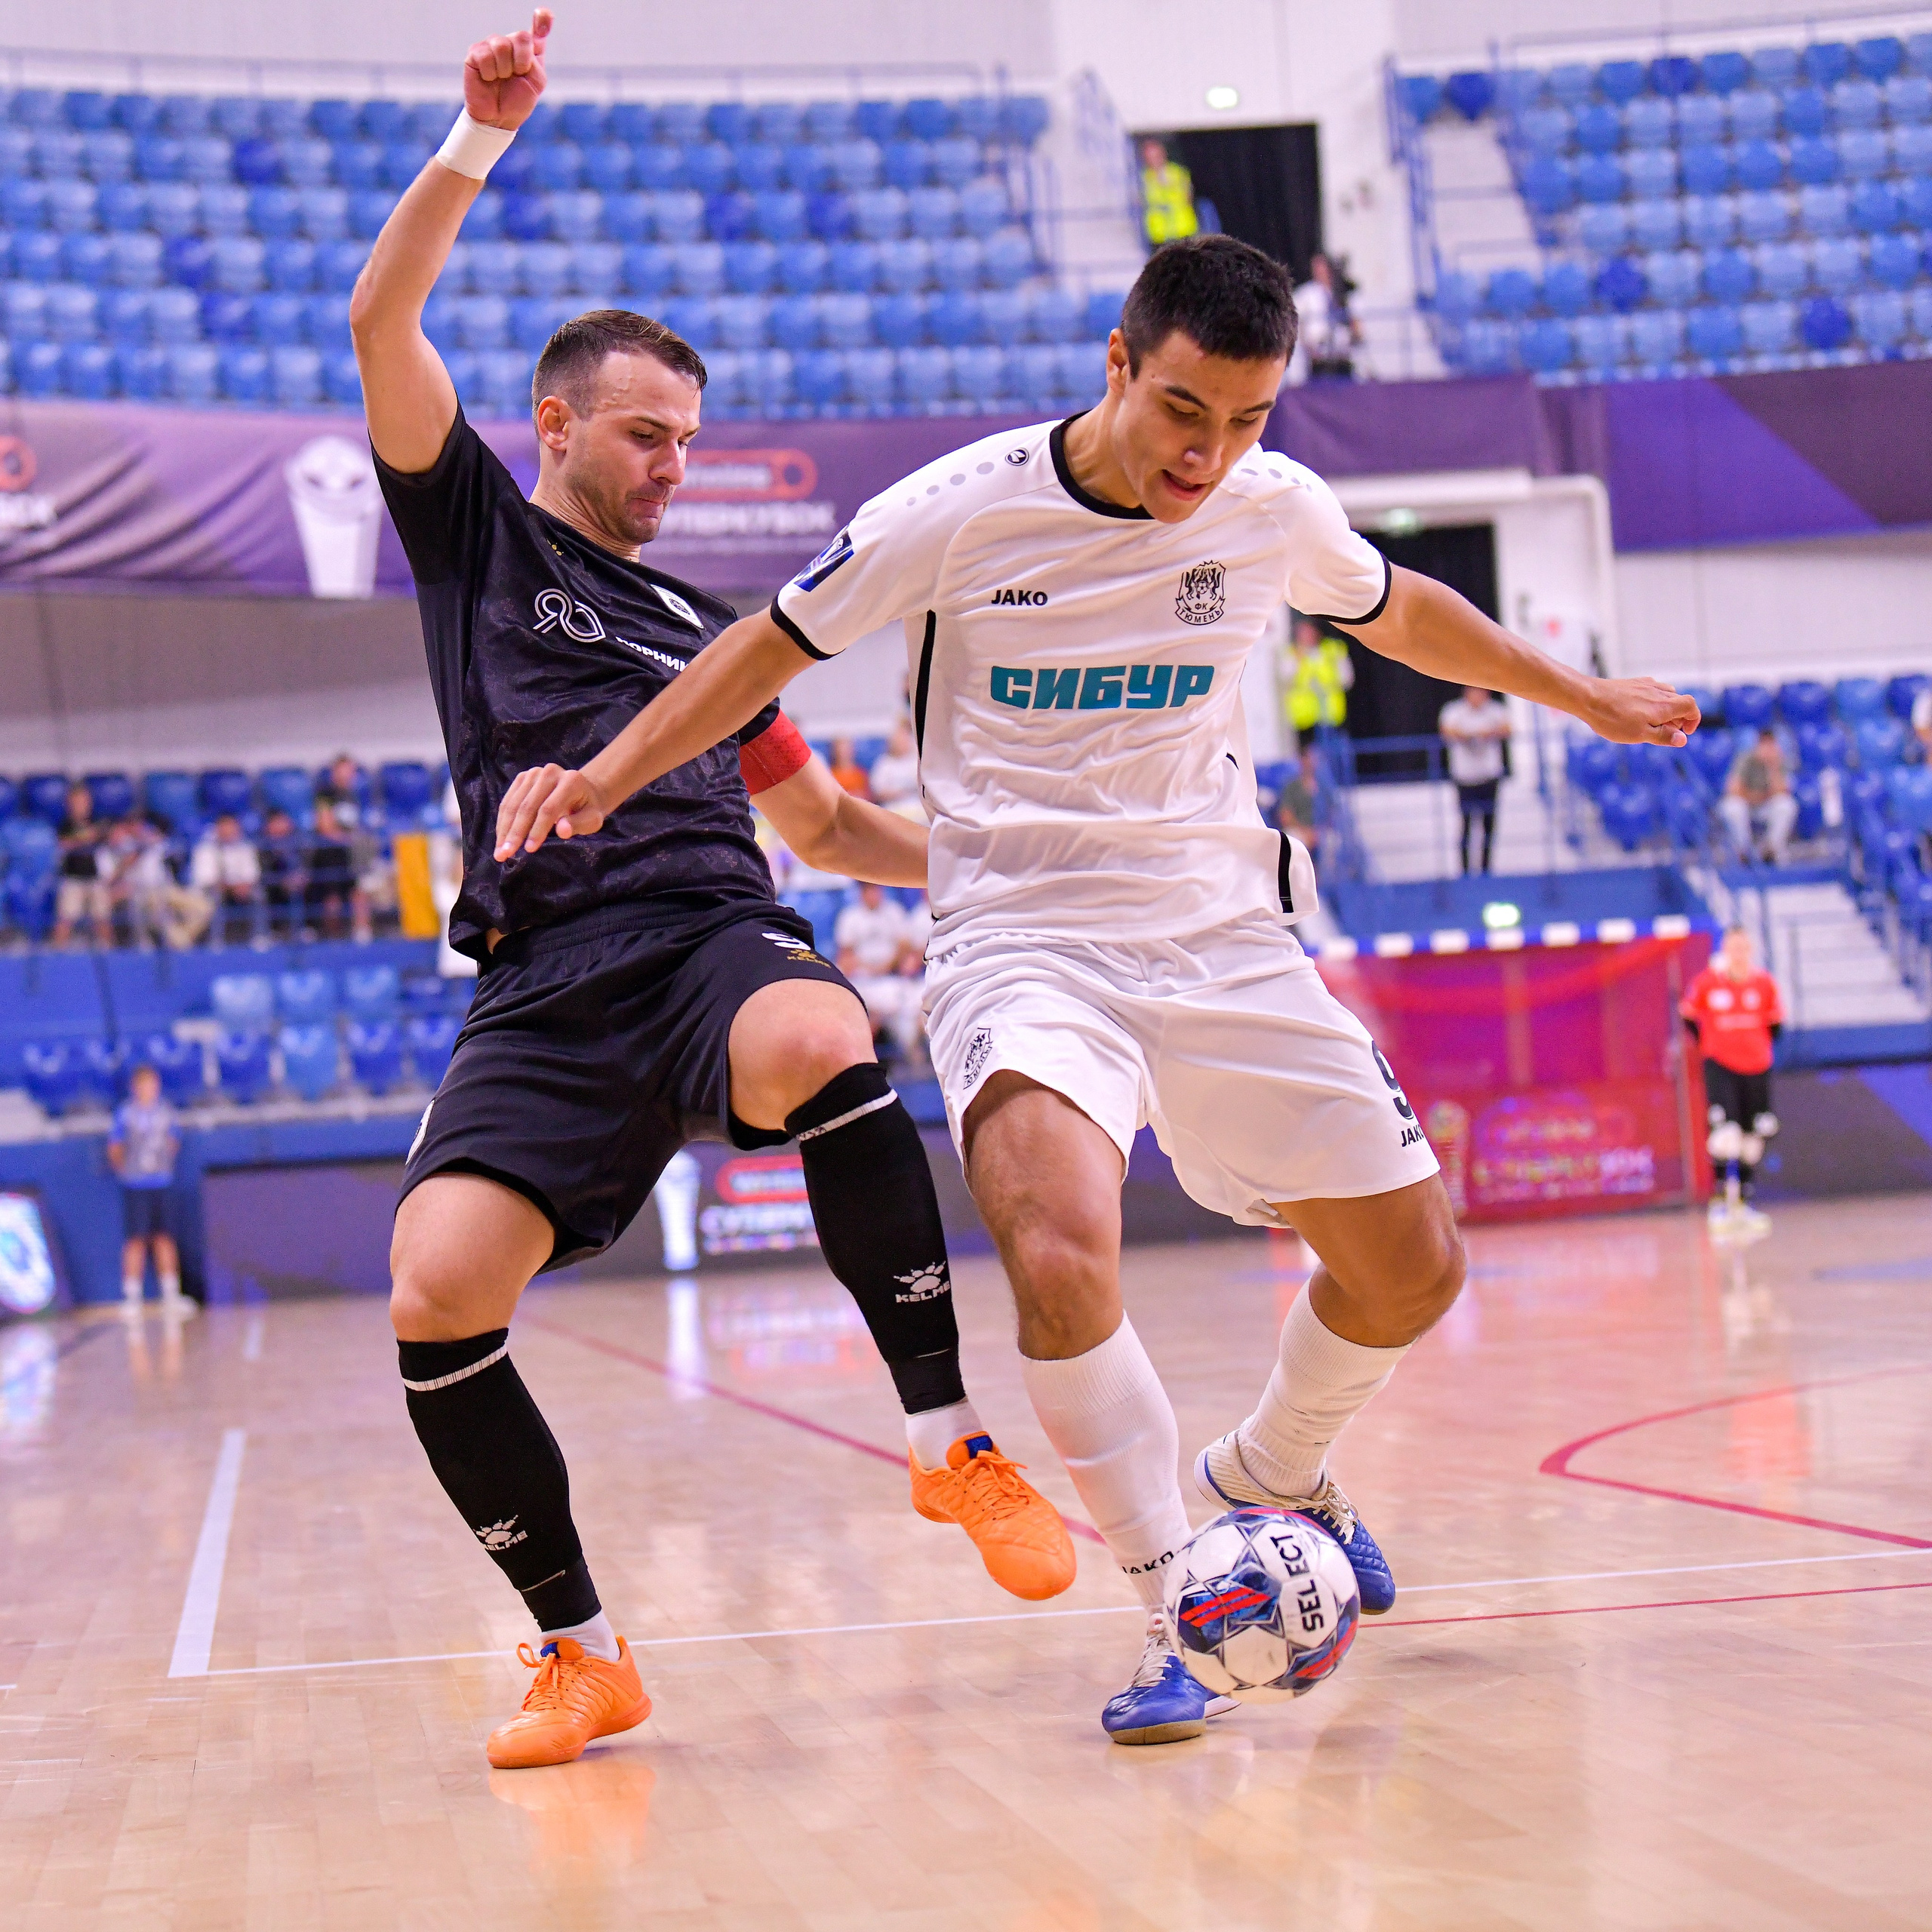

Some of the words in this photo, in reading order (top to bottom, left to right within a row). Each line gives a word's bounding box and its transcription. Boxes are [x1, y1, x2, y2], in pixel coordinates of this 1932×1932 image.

[991, 586, 1049, 606] JAKO
[1179, 608, 1221, 623] ТЮМЕНЬ
[990, 664, 1215, 710] СИБУР
[894, 1280, 951, 1303] KELME
[1269, 1534, 1324, 1632] SELECT
